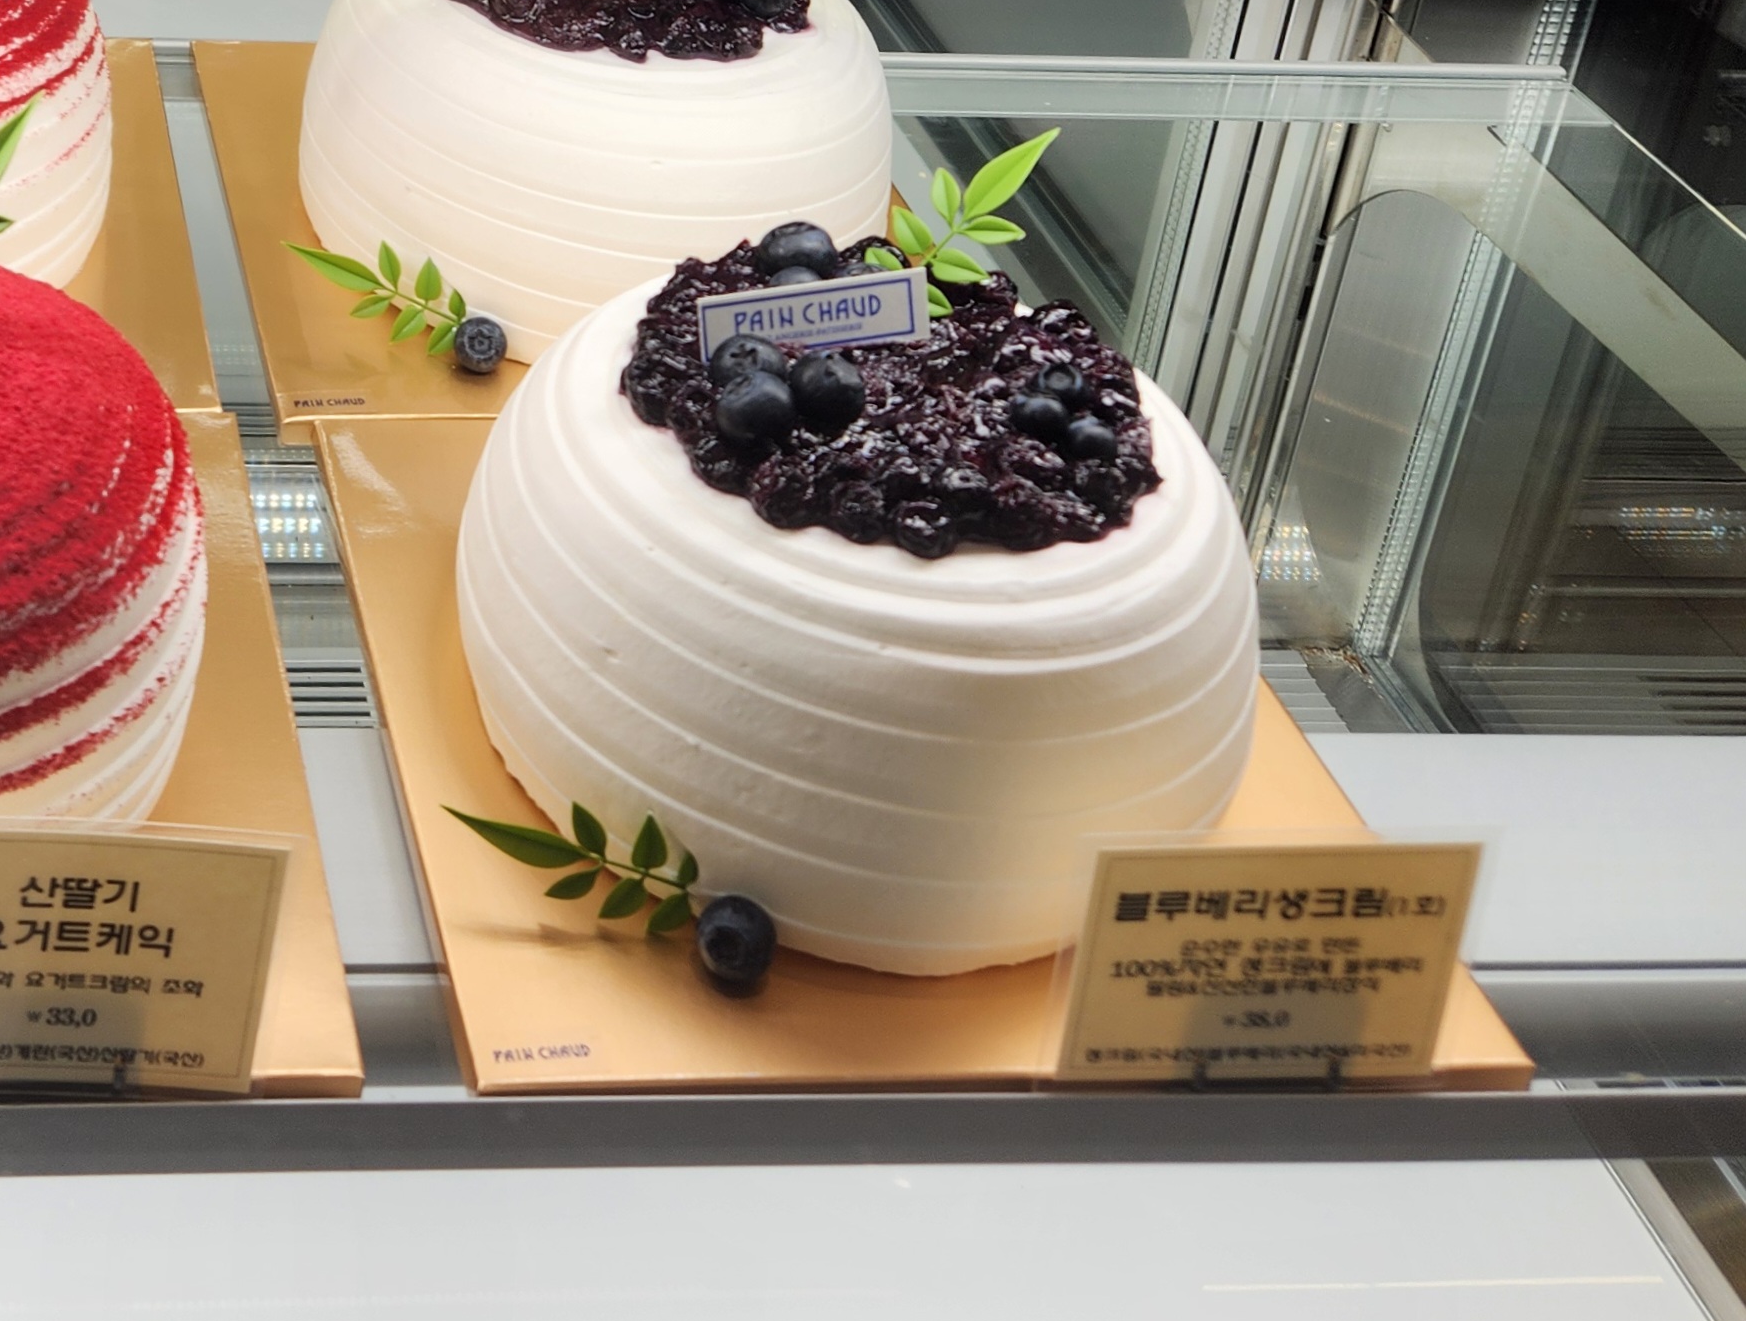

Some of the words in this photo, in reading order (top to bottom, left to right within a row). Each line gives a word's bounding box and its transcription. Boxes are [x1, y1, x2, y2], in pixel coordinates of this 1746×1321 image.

[734, 305, 794, 336] PAIN
[802, 293, 882, 325] CHAUD
[294, 398, 324, 408] PAIN
[326, 397, 366, 407] CHAUD
[19, 875, 141, 913] 산딸기
[161, 977, 205, 999] 조화
[493, 1046, 534, 1063] PAIN
[538, 1043, 592, 1060] CHAUD
